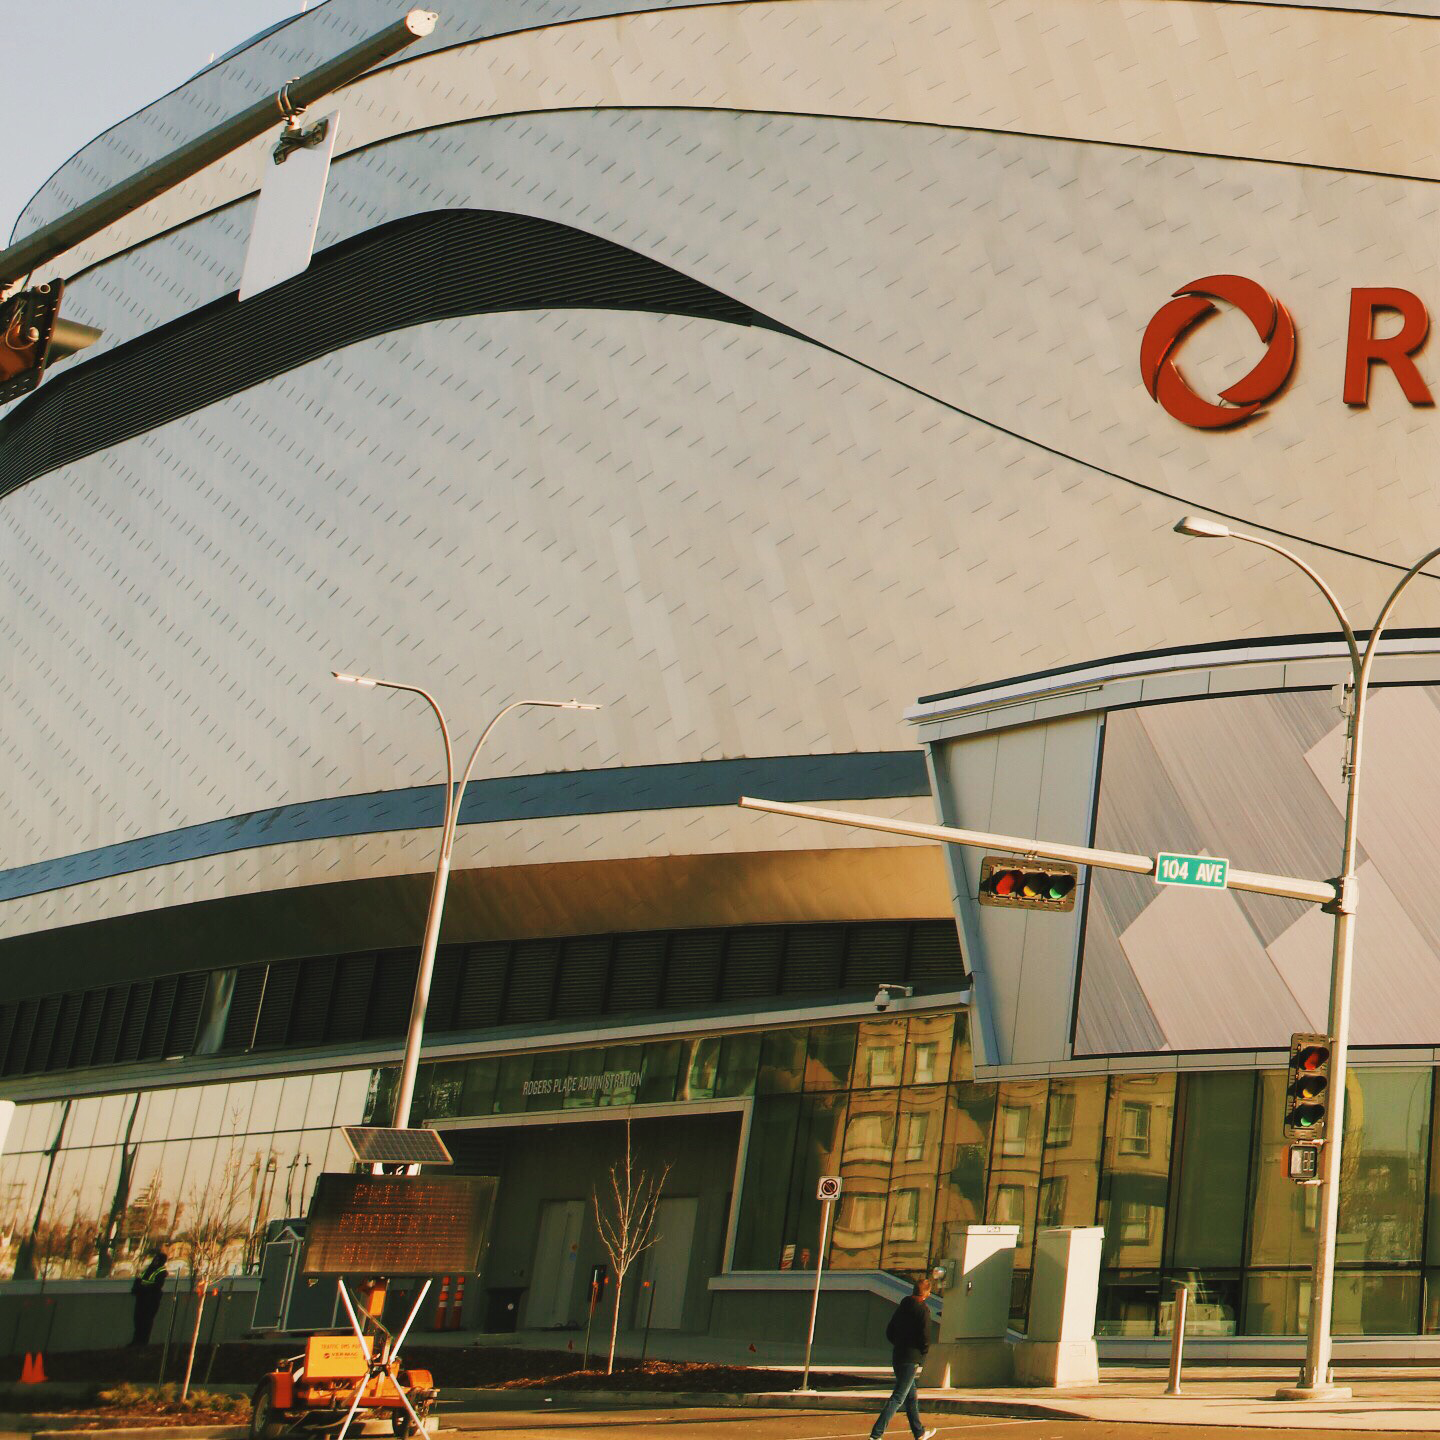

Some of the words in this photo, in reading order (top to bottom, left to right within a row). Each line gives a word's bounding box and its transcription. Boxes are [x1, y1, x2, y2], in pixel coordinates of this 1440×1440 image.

[1162, 859, 1189, 880] 104
[1195, 862, 1224, 883] AVE
[522, 1079, 552, 1096] ROGERS
[552, 1076, 577, 1093] PLACE
[577, 1071, 643, 1091] ADMINISTRATION
